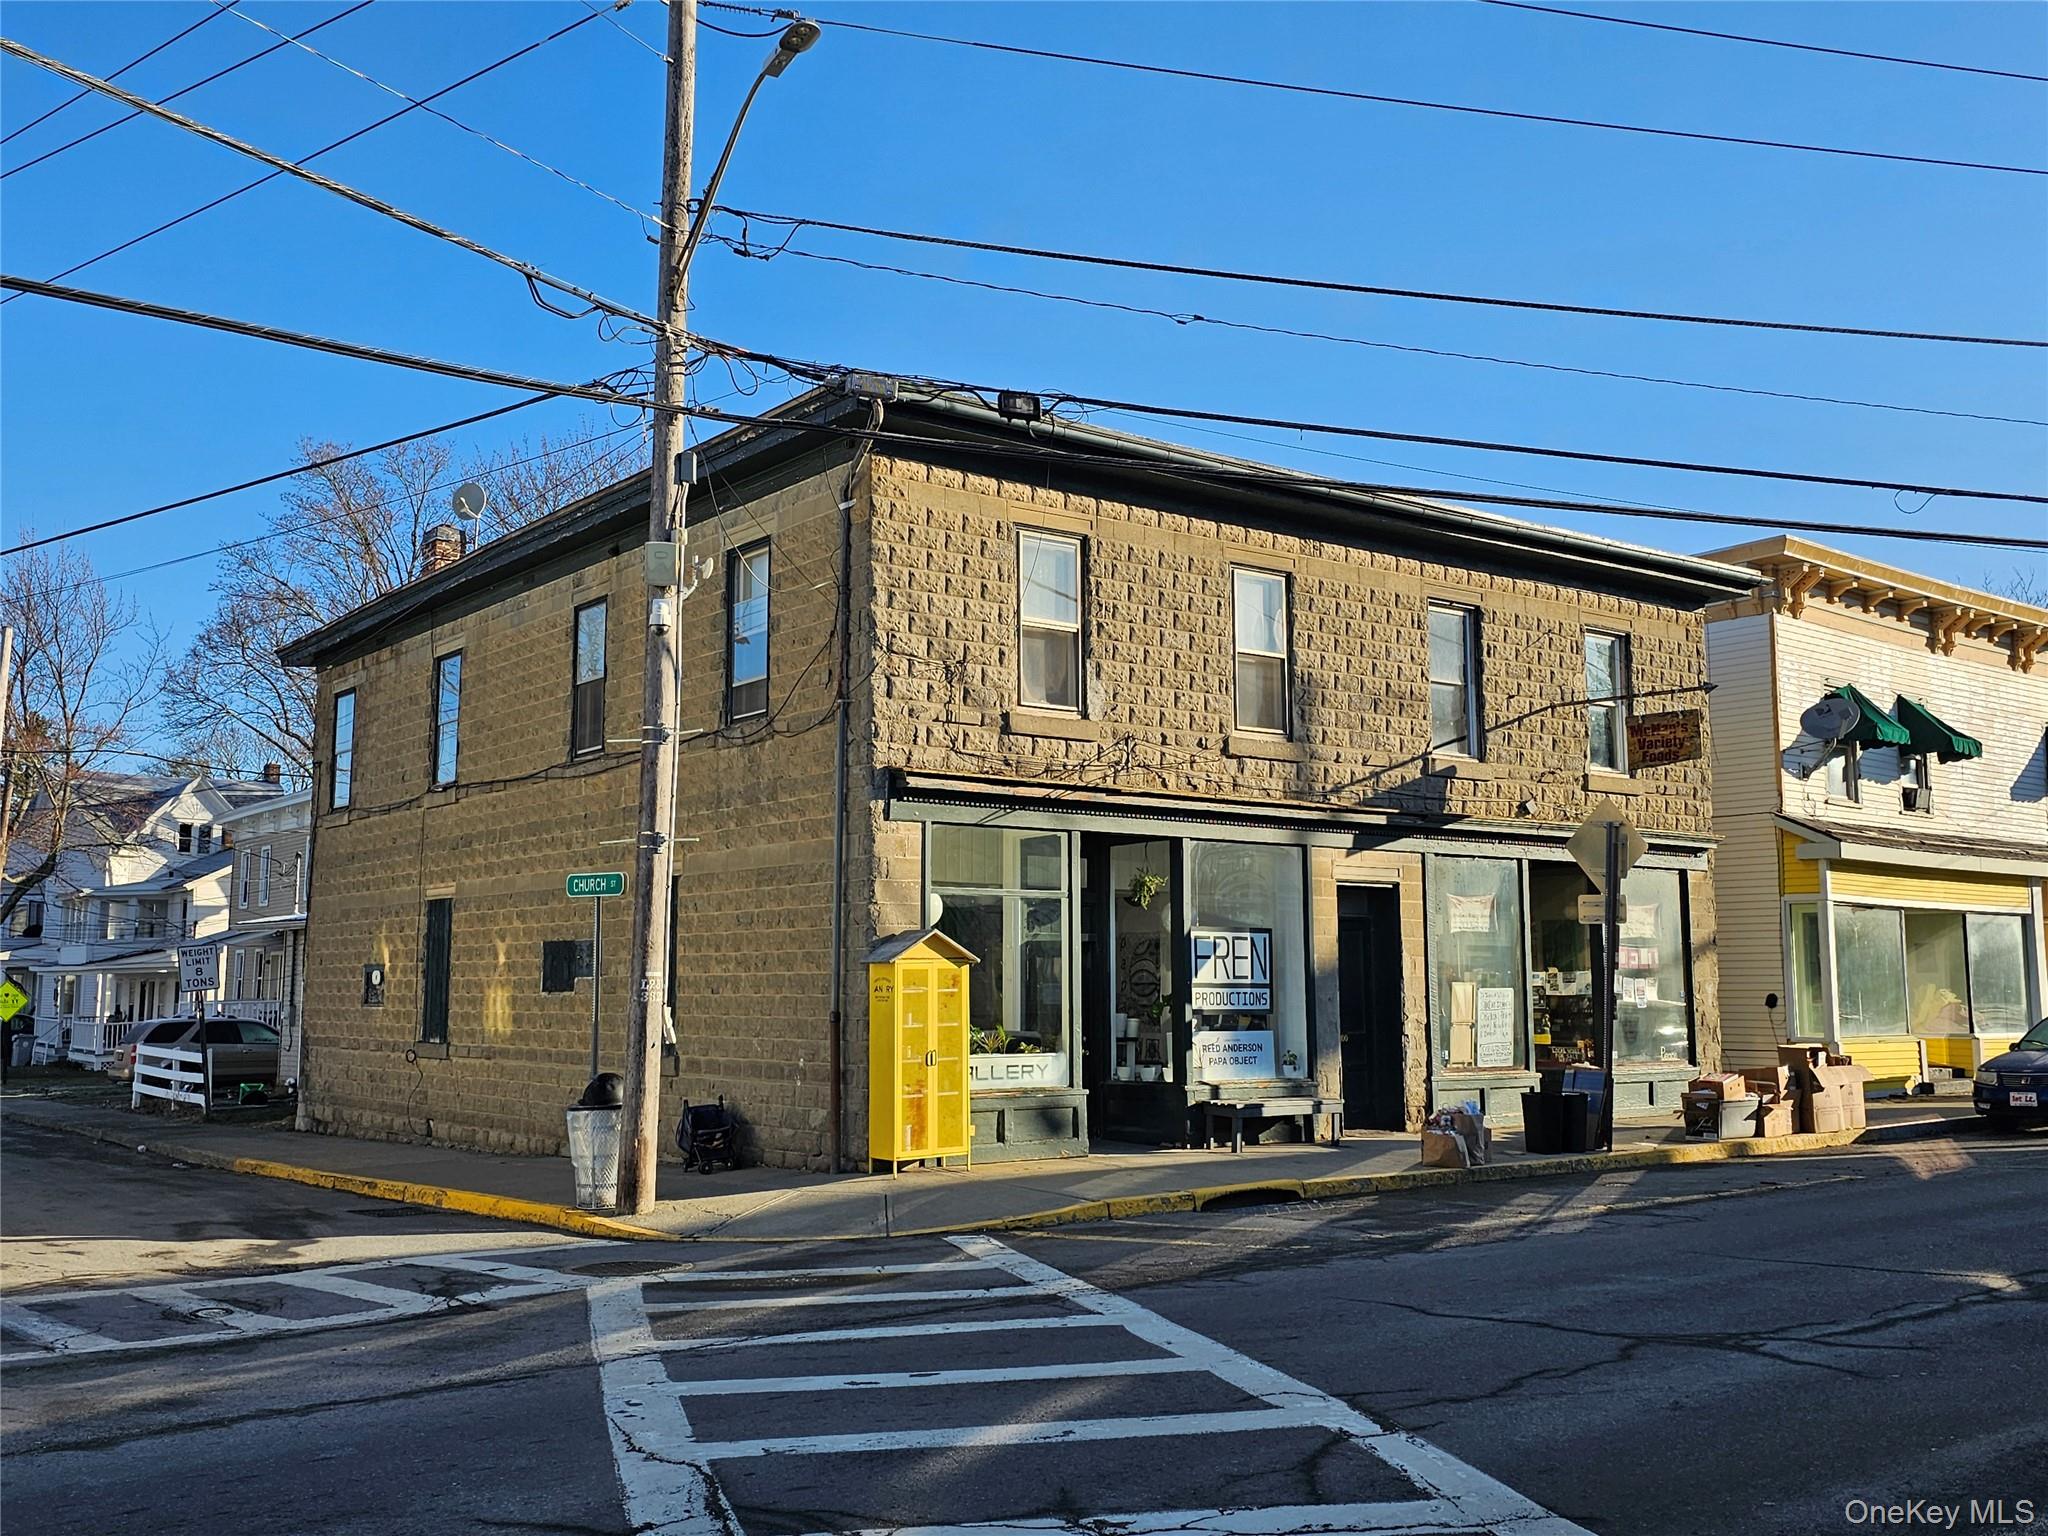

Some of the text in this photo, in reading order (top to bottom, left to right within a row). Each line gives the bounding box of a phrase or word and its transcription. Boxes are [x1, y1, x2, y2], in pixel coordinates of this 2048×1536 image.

[1637, 735, 1685, 750] Variety
[1642, 750, 1680, 762] Foods
[573, 878, 607, 892] CHURCH
[181, 947, 214, 957] WEIGHT
[186, 957, 211, 967] LIMIT
[1193, 936, 1267, 980] FREN
[195, 967, 204, 976] 8
[186, 977, 215, 988] TONS
[1194, 991, 1268, 1006] PRODUCTIONS
[1202, 1043, 1263, 1053] REED ANDERSON
[1209, 1056, 1258, 1066] PAPA OBJECT
